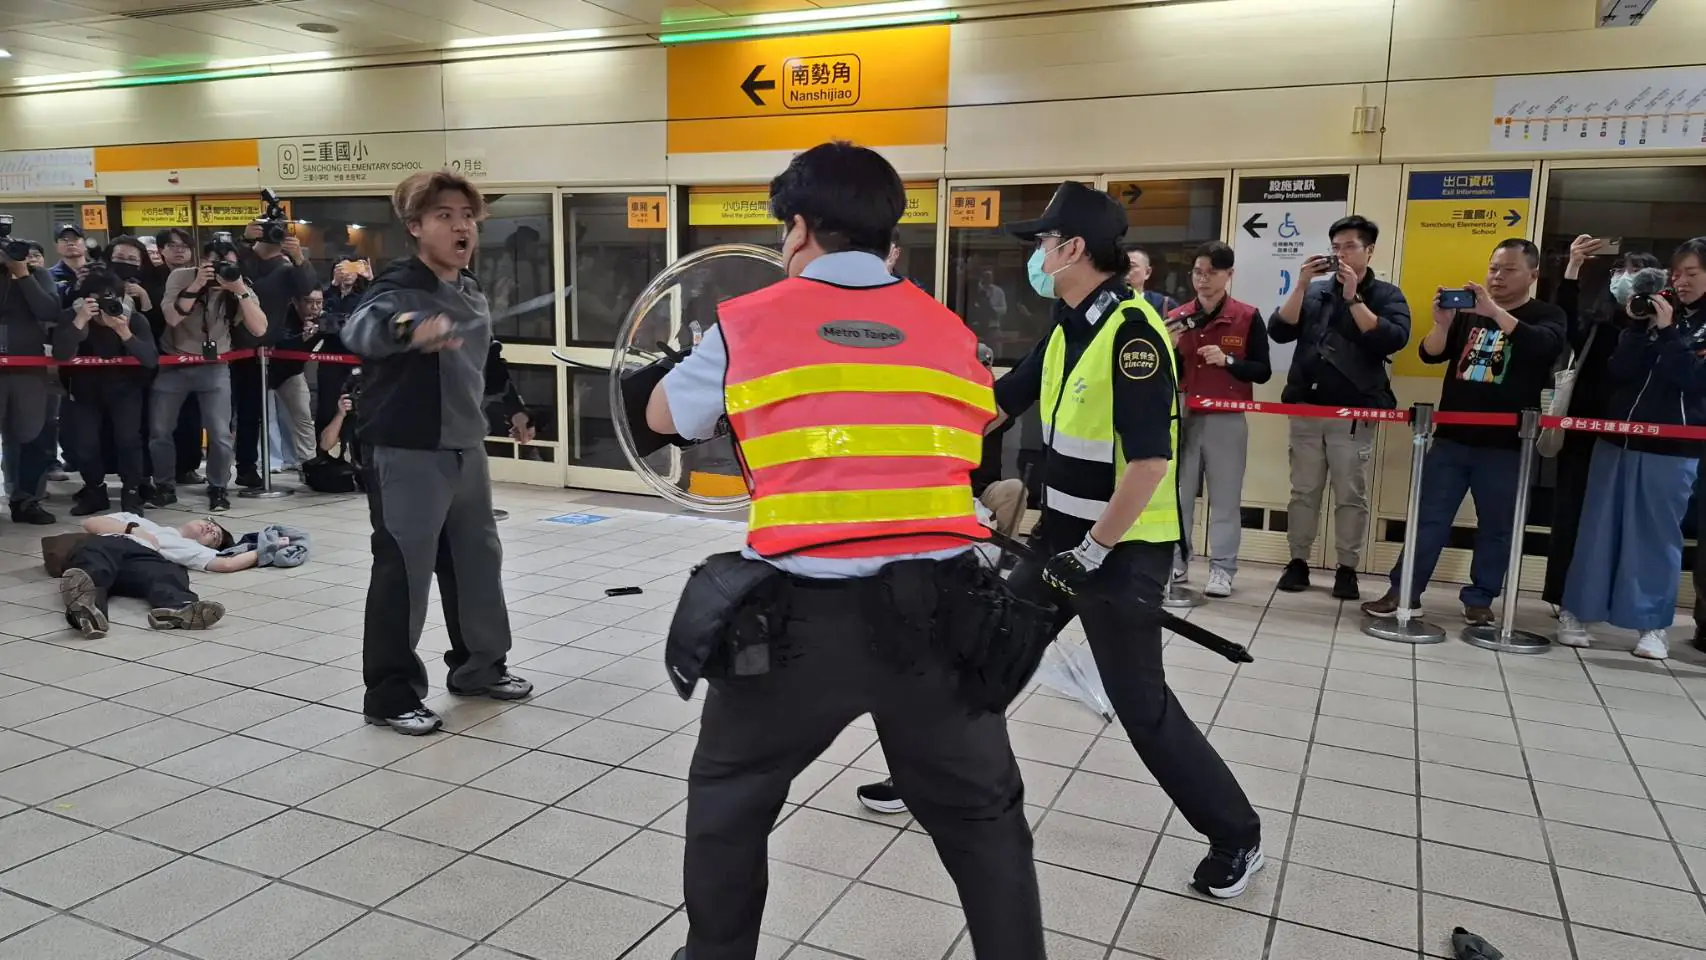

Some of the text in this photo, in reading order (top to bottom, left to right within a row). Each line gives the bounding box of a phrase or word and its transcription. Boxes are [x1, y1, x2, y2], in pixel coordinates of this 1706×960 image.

[791, 61, 850, 86] 南勢角
[790, 88, 852, 102] Nanshijiao
[302, 139, 369, 162] 三重國小
[282, 163, 295, 175] 50
[302, 161, 423, 173] SANCHONG ELEMENTARY SCHOOL
[463, 159, 482, 171] 月台
[1269, 179, 1316, 192] 設施資訊
[1442, 174, 1494, 187] 出口資訊
[1263, 191, 1321, 200] Facility Information
[651, 201, 660, 223] 1
[981, 197, 991, 221] 1
[1451, 209, 1497, 220] 三重國小
[97, 209, 103, 225] 1
[1420, 221, 1497, 229] Sanchong Elementary
[823, 326, 901, 341] Metro Taipei
[1468, 327, 1505, 346] GAME
[1123, 360, 1154, 369] sincere
[1575, 419, 1660, 435] 台北捷運公司
